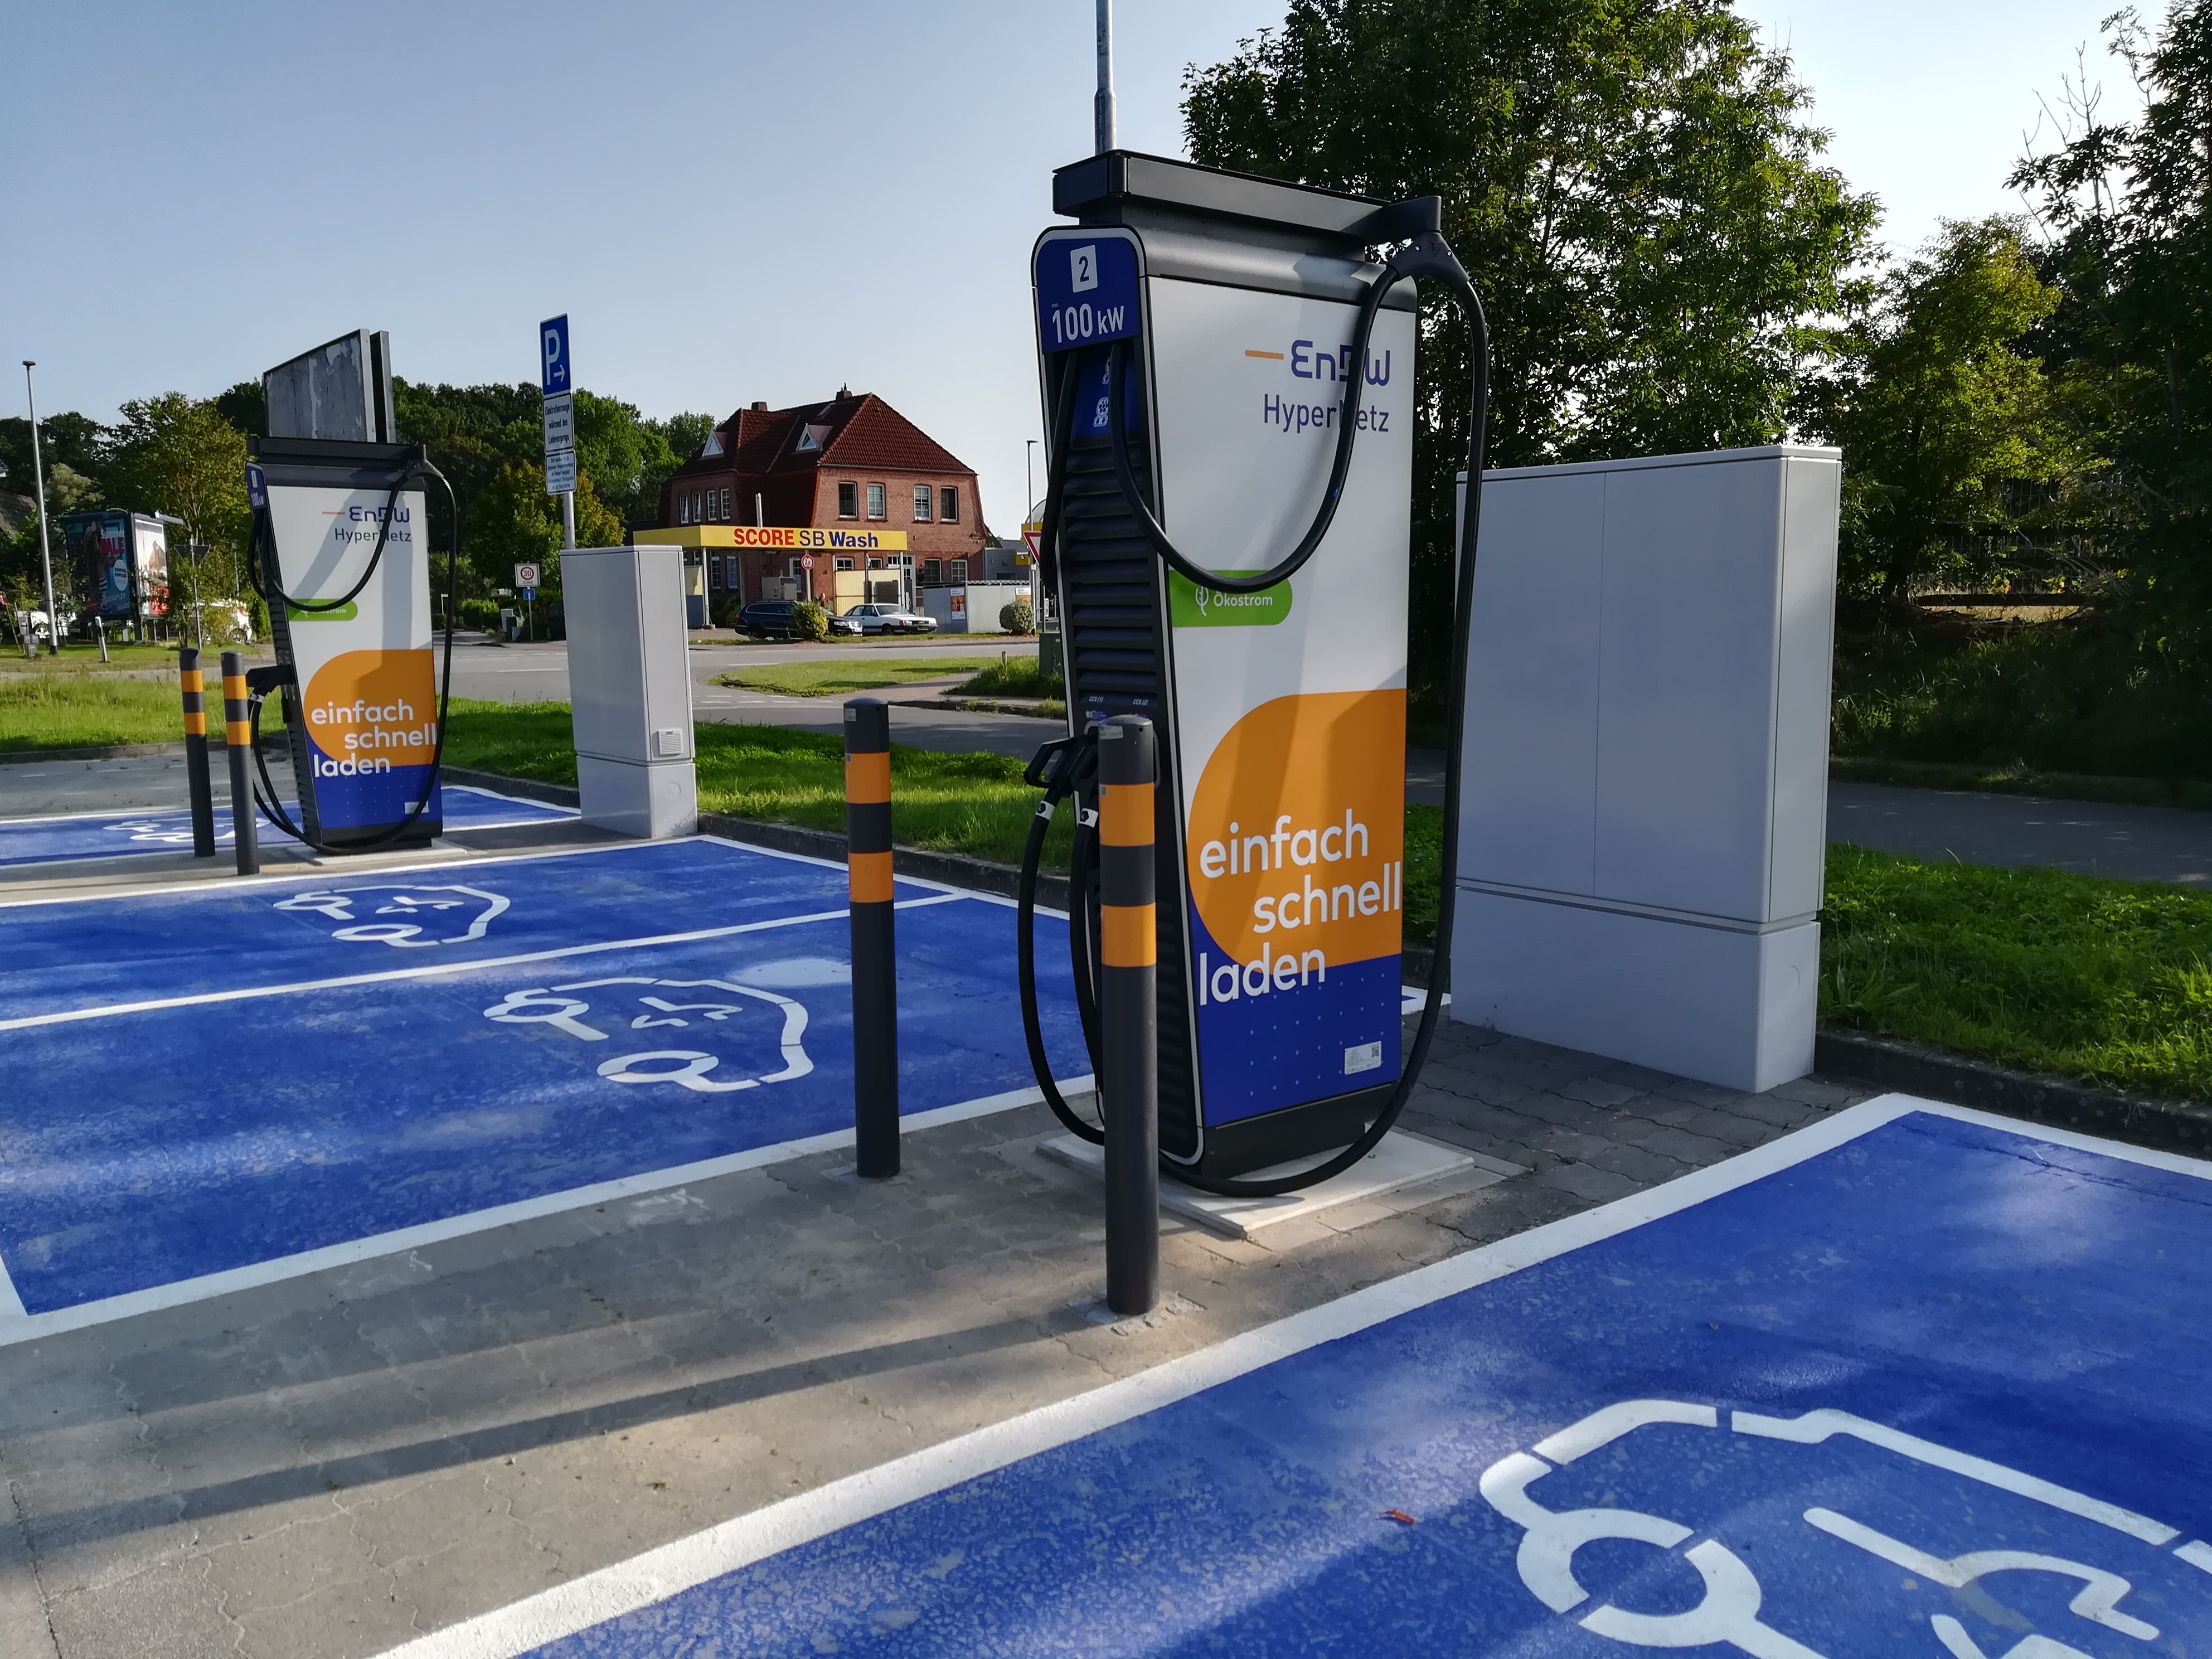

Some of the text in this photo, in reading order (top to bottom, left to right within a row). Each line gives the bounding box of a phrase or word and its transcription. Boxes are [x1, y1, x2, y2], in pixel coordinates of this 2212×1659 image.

[1079, 256, 1090, 283] 2
[1052, 303, 1124, 343] 100 kW
[545, 328, 560, 386] P
[734, 528, 879, 548] SCORE SB Wash
[1213, 591, 1273, 607] Ökostrom
[311, 698, 414, 725] einfach
[345, 723, 437, 750] schnell
[313, 753, 391, 778] laden
[1200, 809, 1369, 879] einfach
[1253, 861, 1401, 934] schnell
[1200, 942, 1326, 1006] laden
